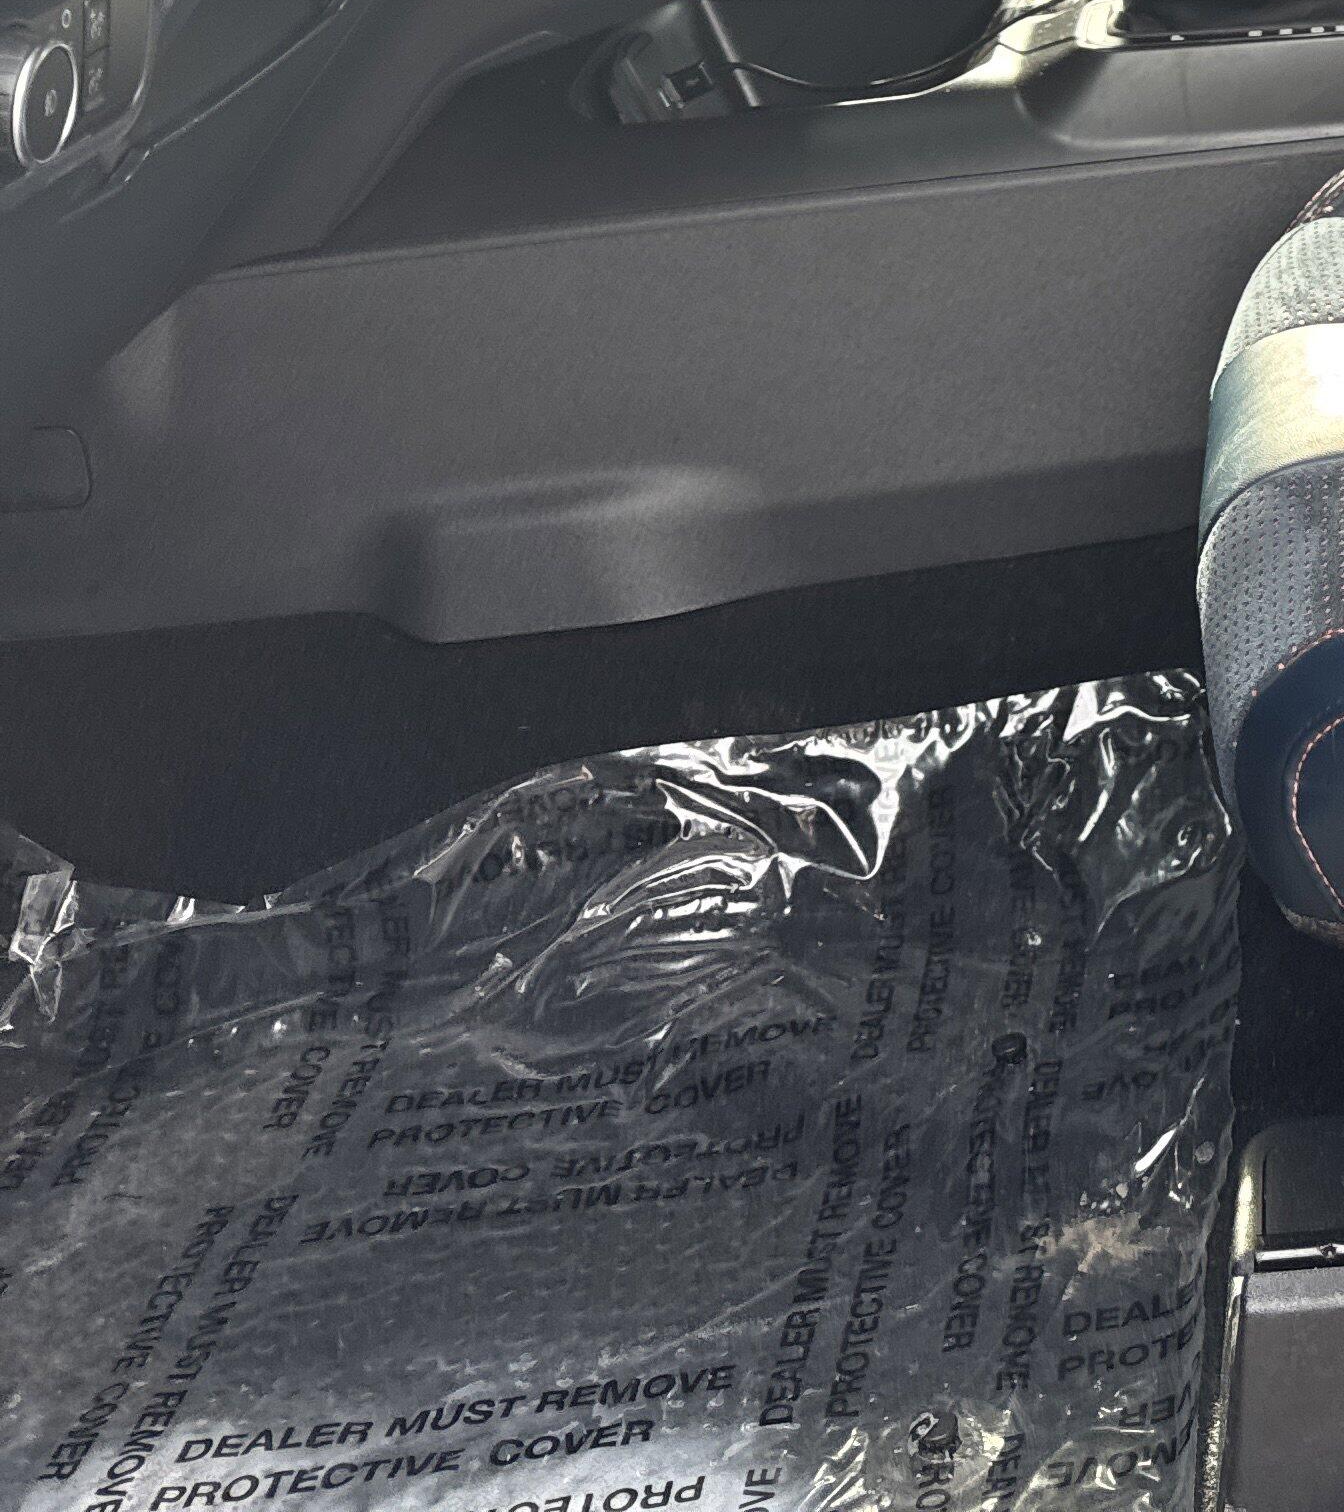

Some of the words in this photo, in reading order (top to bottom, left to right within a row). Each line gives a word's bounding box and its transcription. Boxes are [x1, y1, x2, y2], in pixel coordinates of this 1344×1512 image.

[263, 1045, 331, 1131] COVER
[303, 1058, 383, 1159] REMOVE
[366, 1098, 623, 1150] PROTECTIVE
[644, 1060, 773, 1116] COVER
[384, 1078, 543, 1115] DEALER
[383, 1162, 531, 1198] COVER
[818, 1091, 862, 1224] REMOVE
[869, 1121, 912, 1231] COVER
[112, 1203, 236, 1376] PROTECTIVE
[212, 1194, 300, 1298] DEALER
[168, 1300, 238, 1384] MUST
[758, 1310, 821, 1426] DEALER
[824, 1235, 899, 1421] PROTECTIVE
[38, 1379, 132, 1483] COVER
[174, 1420, 374, 1464] DEALER
[384, 1394, 527, 1438] MUST
[533, 1363, 739, 1415] REMOVE
[150, 1446, 466, 1512] PROTECTIVE
[487, 1417, 658, 1469] COVER
